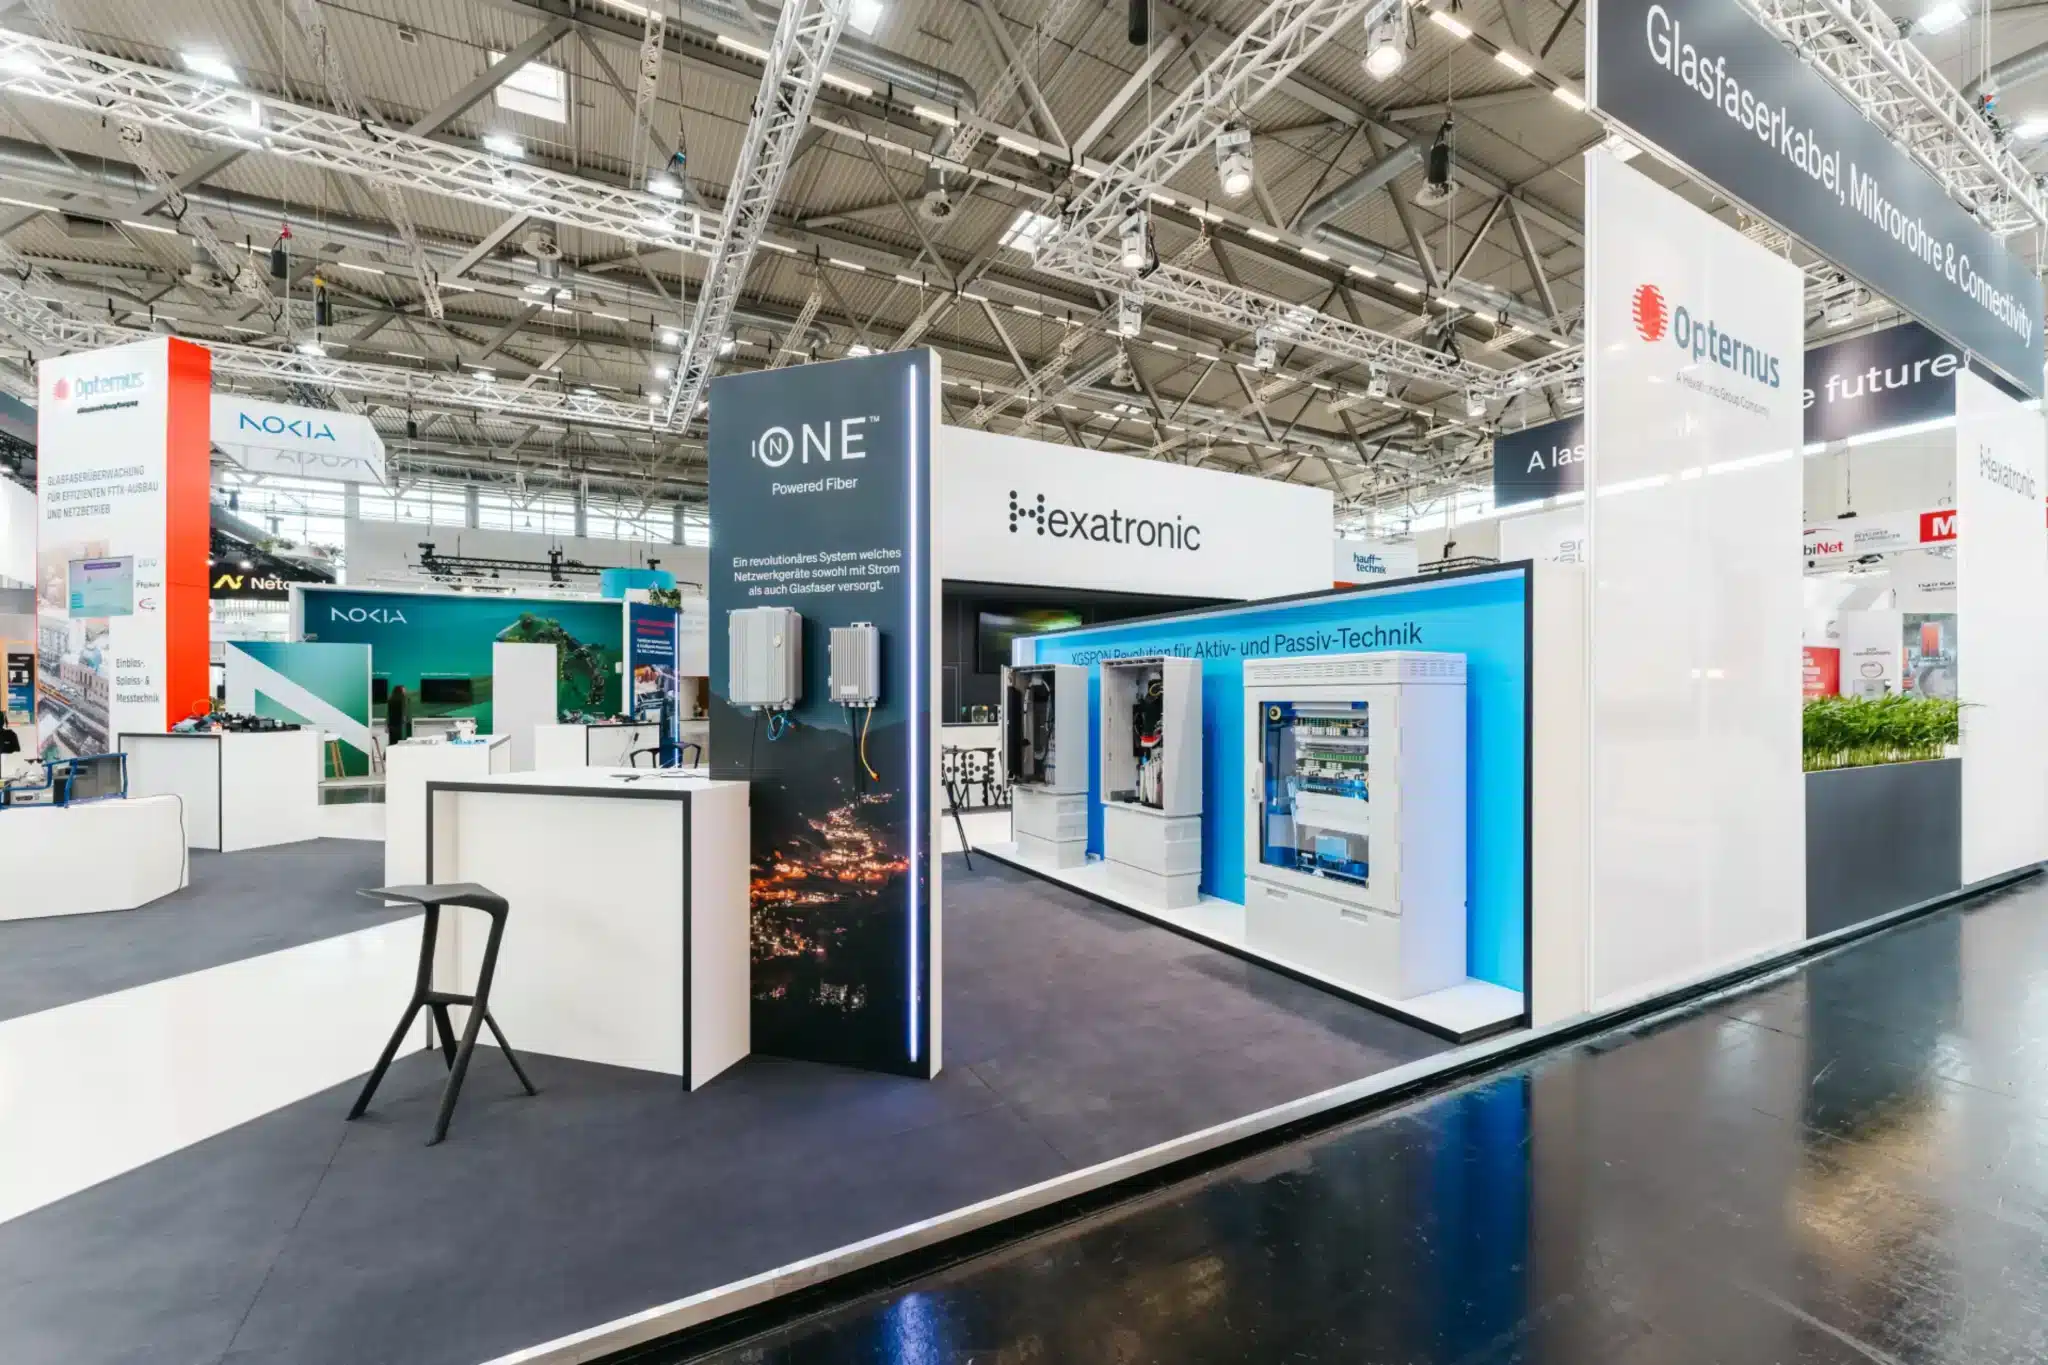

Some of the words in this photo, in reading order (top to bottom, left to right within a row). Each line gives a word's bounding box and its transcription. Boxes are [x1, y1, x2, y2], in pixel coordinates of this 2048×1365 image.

[1646, 5, 1845, 206] Glasfaserkabel,
[1851, 162, 1943, 272] Mikrorohre
[1945, 242, 1957, 284] &
[1959, 254, 2033, 348] Connectivity
[1674, 306, 1780, 388] Opternus
[75, 372, 144, 400] Opternus
[1825, 353, 1958, 403] future
[1720, 387, 1740, 407] Group
[239, 412, 336, 441] NOKIA
[1526, 450, 1546, 473] A
[1979, 443, 2036, 500] Hexatronic
[62, 487, 106, 501] EFFIZIENTEN
[772, 479, 823, 495] Powered
[826, 476, 858, 490] Fiber
[47, 508, 62, 520] UND
[63, 504, 111, 518] NETZBETRIEB
[1009, 490, 1201, 551] Hexatronic
[733, 557, 748, 567] Ein
[750, 552, 818, 566] revolutionäres
[819, 550, 857, 563] System
[859, 549, 902, 561] welches
[1803, 541, 1844, 556] biNet
[734, 567, 810, 583] Netzwerkgeräte
[812, 566, 847, 578] sowohl
[849, 565, 866, 575] mit
[868, 563, 900, 574] Strom
[1356, 563, 1387, 574] technik
[749, 586, 763, 596] als
[764, 584, 788, 595] auch
[789, 580, 836, 594] Glasfaser
[838, 580, 884, 593] versorgt.
[331, 607, 407, 624] NOKIA
[1174, 643, 1192, 658] für
[1194, 639, 1236, 658] Aktiv-
[1240, 636, 1270, 656] und
[1274, 621, 1423, 654] Passiv-Technik
[145, 676, 150, 685] &
[115, 694, 159, 704] Messtechnik
